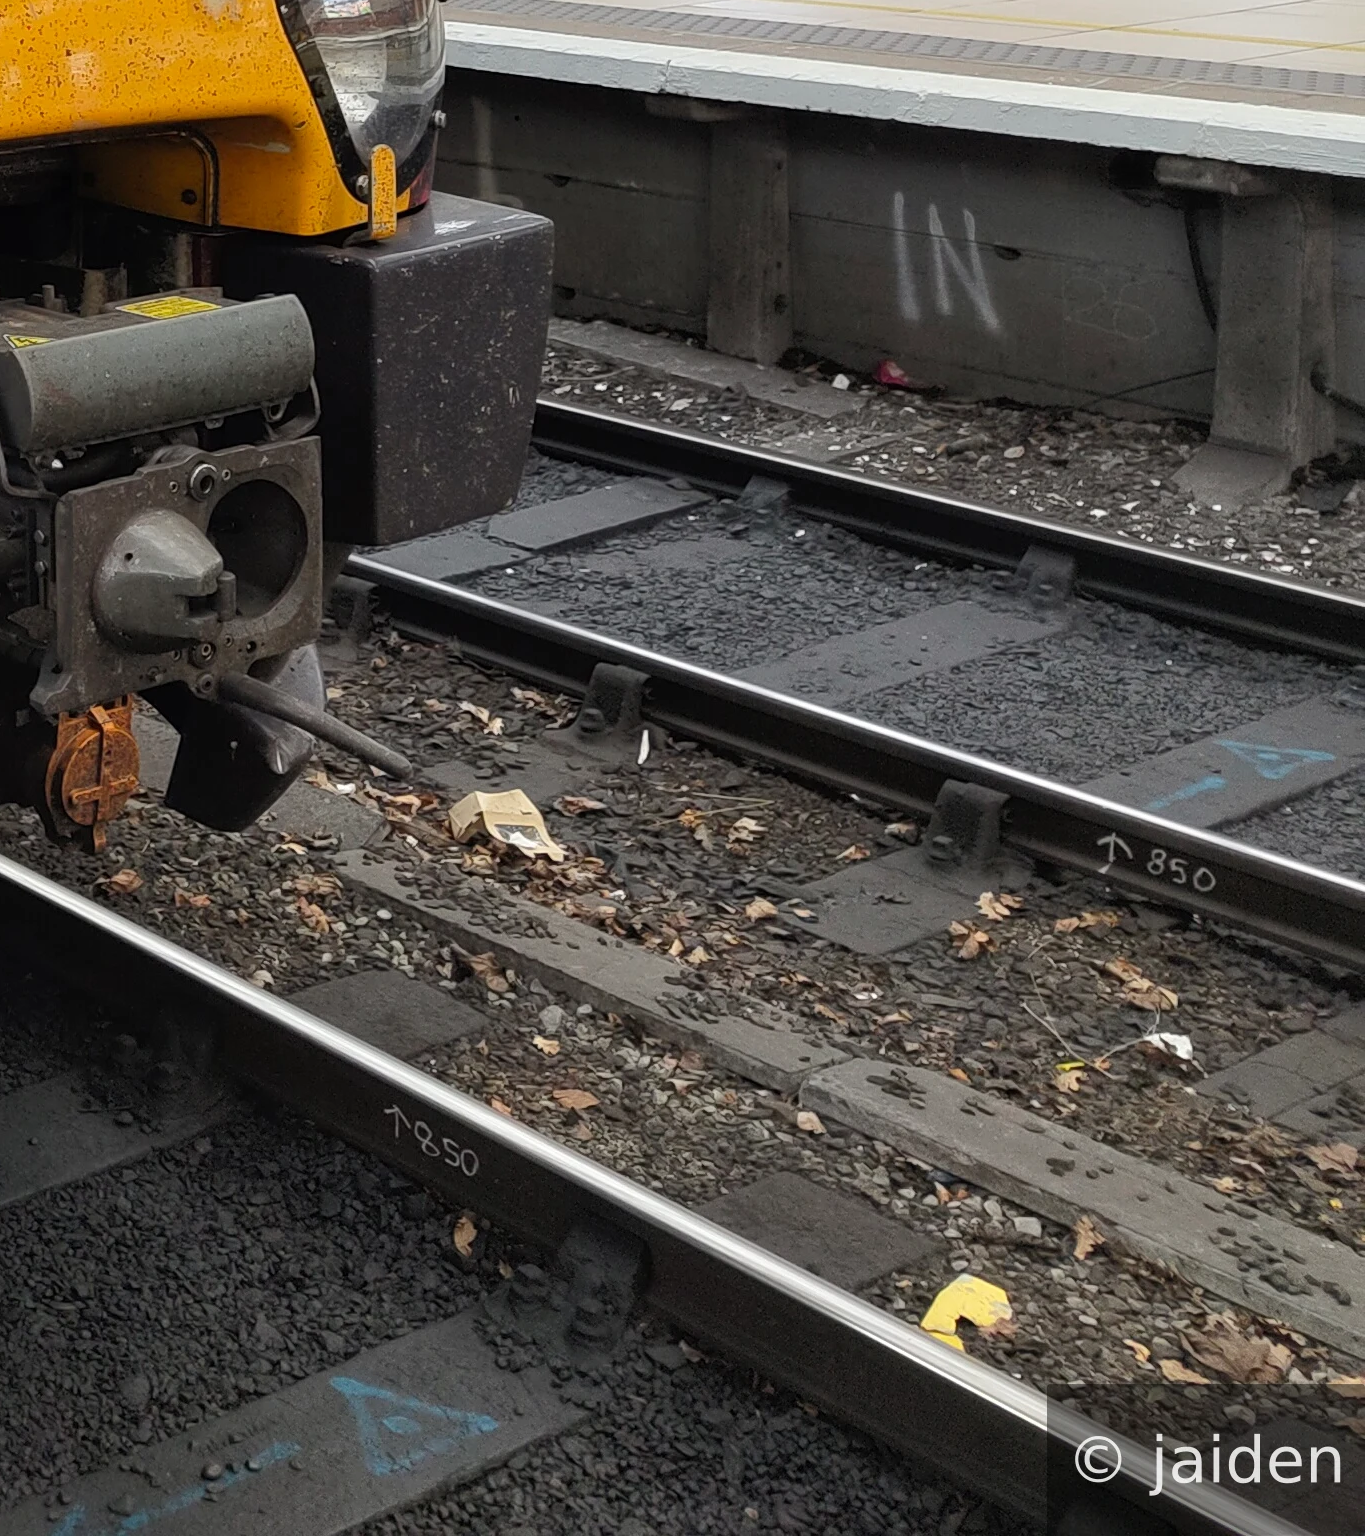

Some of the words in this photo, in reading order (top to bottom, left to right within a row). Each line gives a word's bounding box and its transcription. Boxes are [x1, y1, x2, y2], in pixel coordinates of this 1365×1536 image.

[893, 190, 1002, 333] IN
[1147, 848, 1217, 893] 850
[414, 1120, 480, 1177] 850
